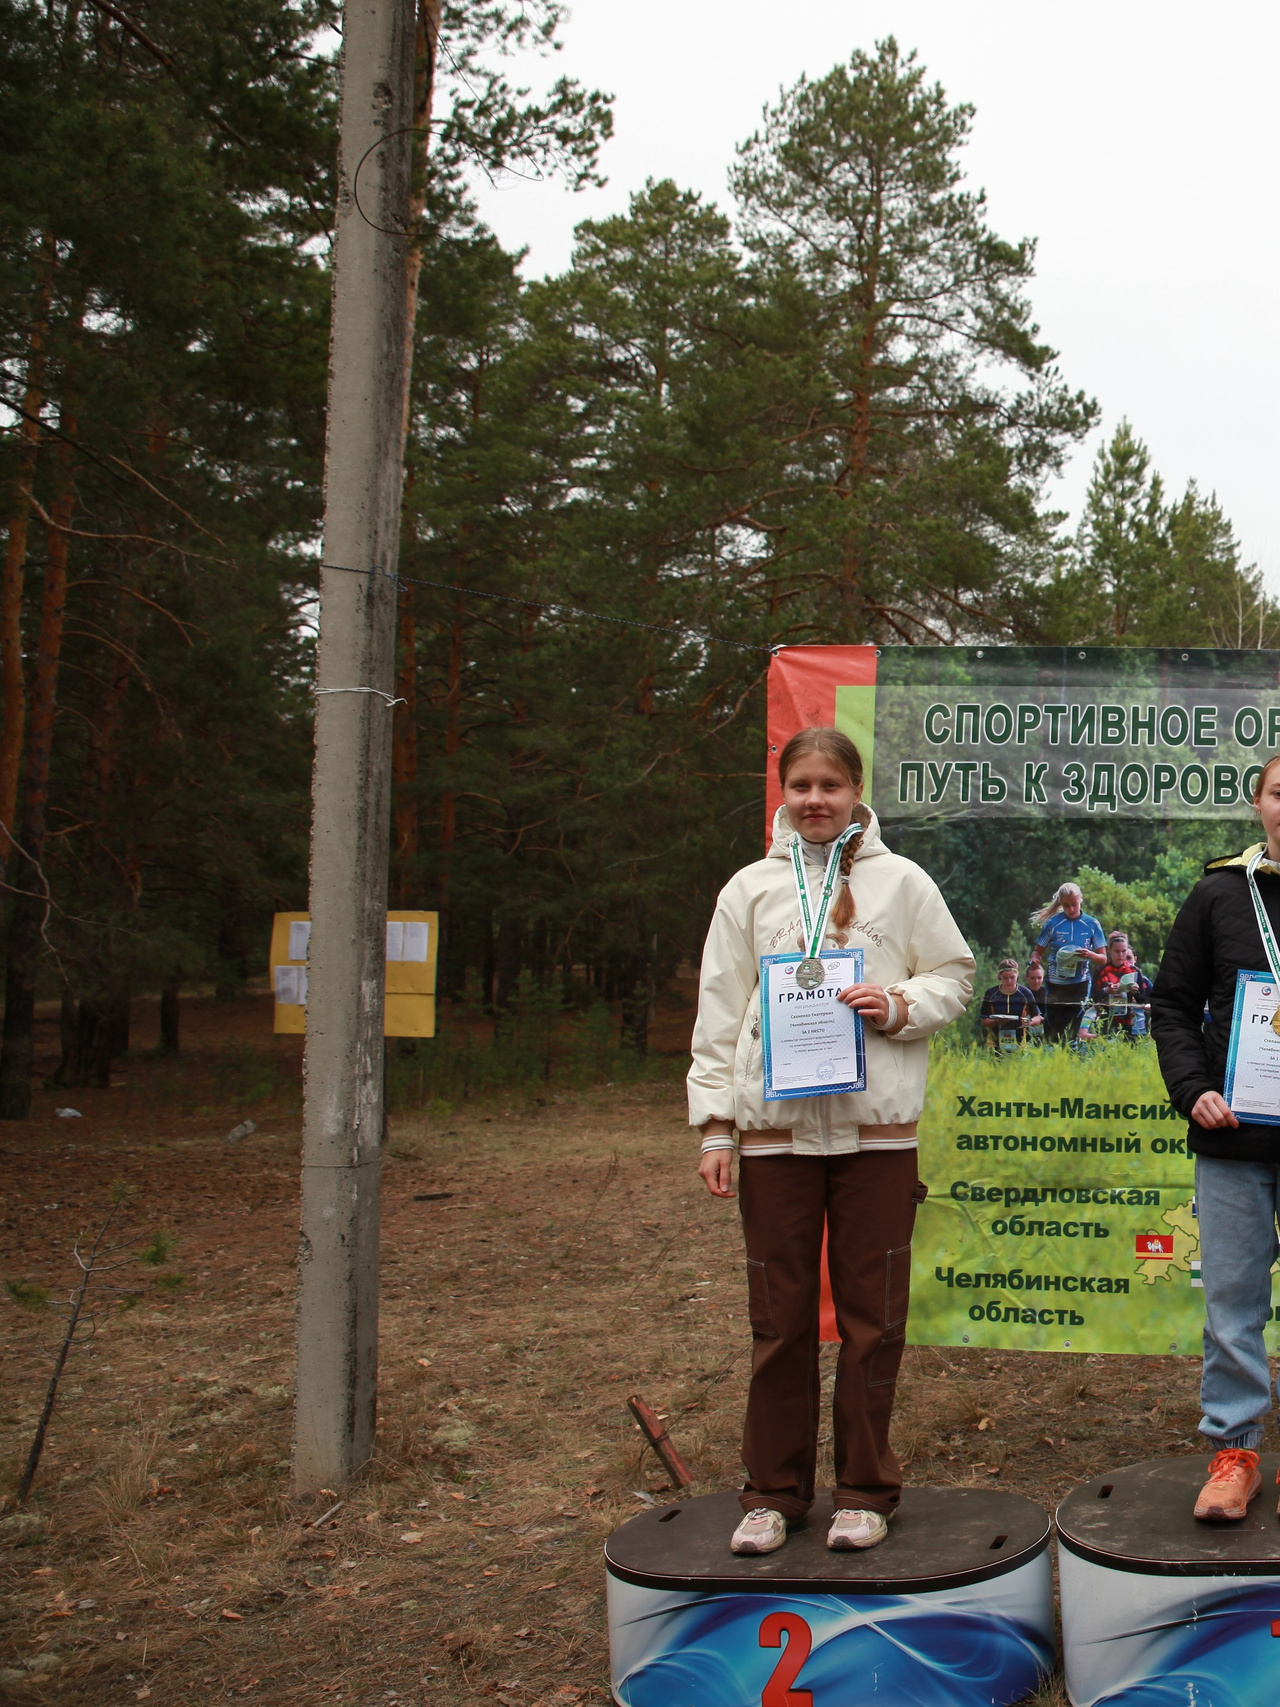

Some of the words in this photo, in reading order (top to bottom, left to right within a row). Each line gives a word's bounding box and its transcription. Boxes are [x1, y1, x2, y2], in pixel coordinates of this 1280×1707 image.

[924, 704, 1218, 748] СПОРТИВНОЕ
[900, 760, 1007, 804] ПУТЬ
[1024, 762, 1048, 804] К
[849, 920, 883, 948] udios
[778, 987, 842, 1004] ГРАМОТА
[956, 1096, 1189, 1120] Ханты-Мансий
[956, 1132, 1141, 1154] автономный
[950, 1180, 1160, 1208] Свердловская
[991, 1214, 1110, 1238] область
[935, 1266, 1130, 1294] Челябинская
[968, 1300, 1085, 1326] область
[758, 1611, 813, 1707] 2
